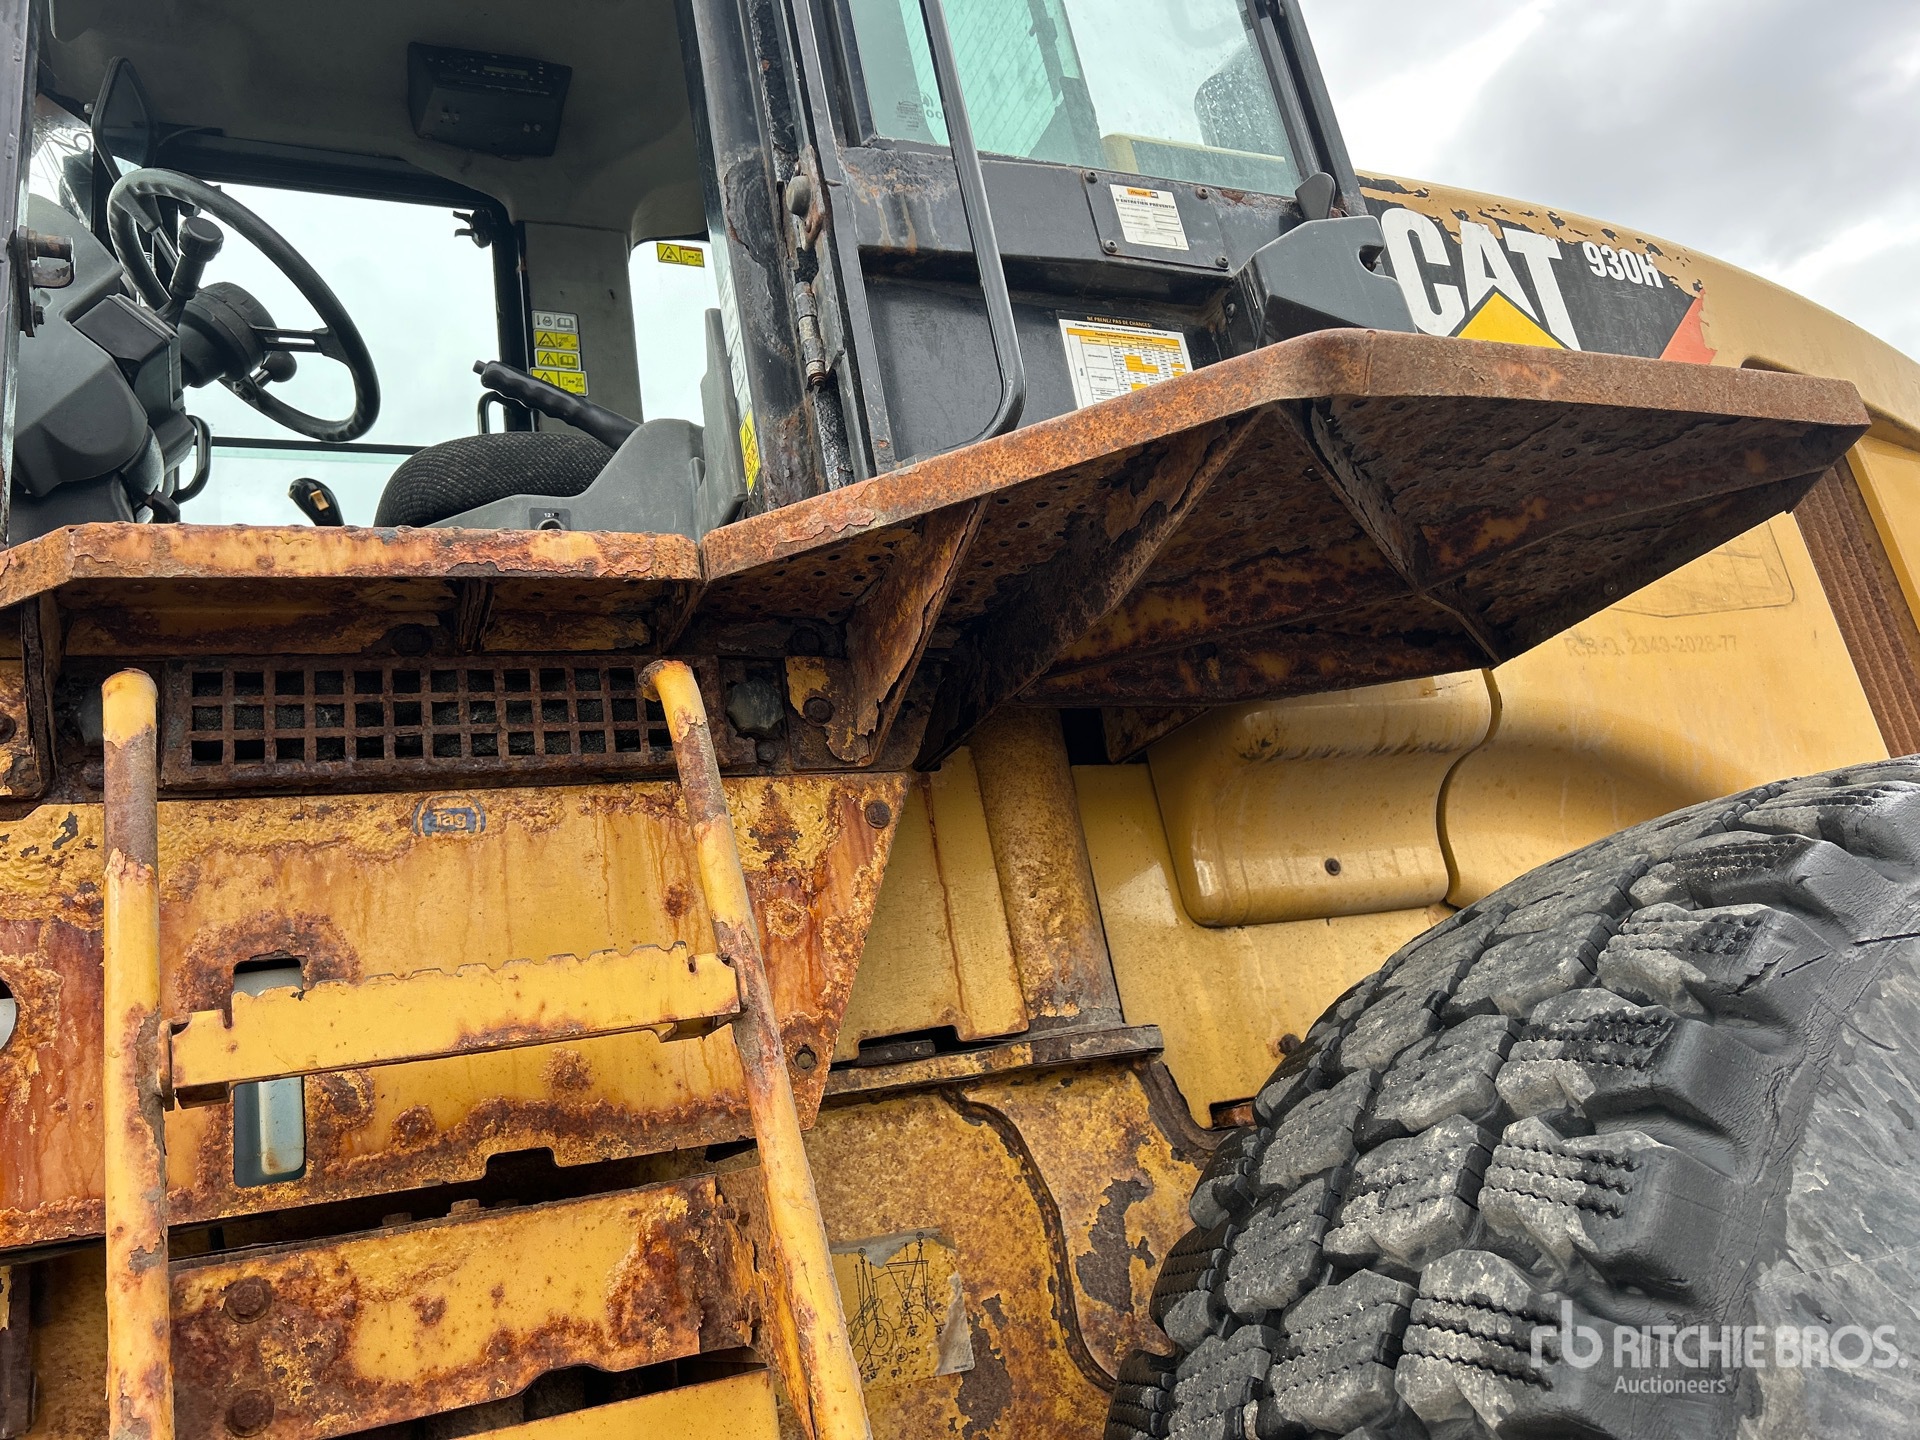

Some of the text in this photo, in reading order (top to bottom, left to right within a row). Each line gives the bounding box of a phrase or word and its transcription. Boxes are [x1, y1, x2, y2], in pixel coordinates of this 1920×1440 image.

[1381, 207, 1581, 351] CAT
[1582, 241, 1665, 289] 930H
[432, 811, 467, 829] Tag
